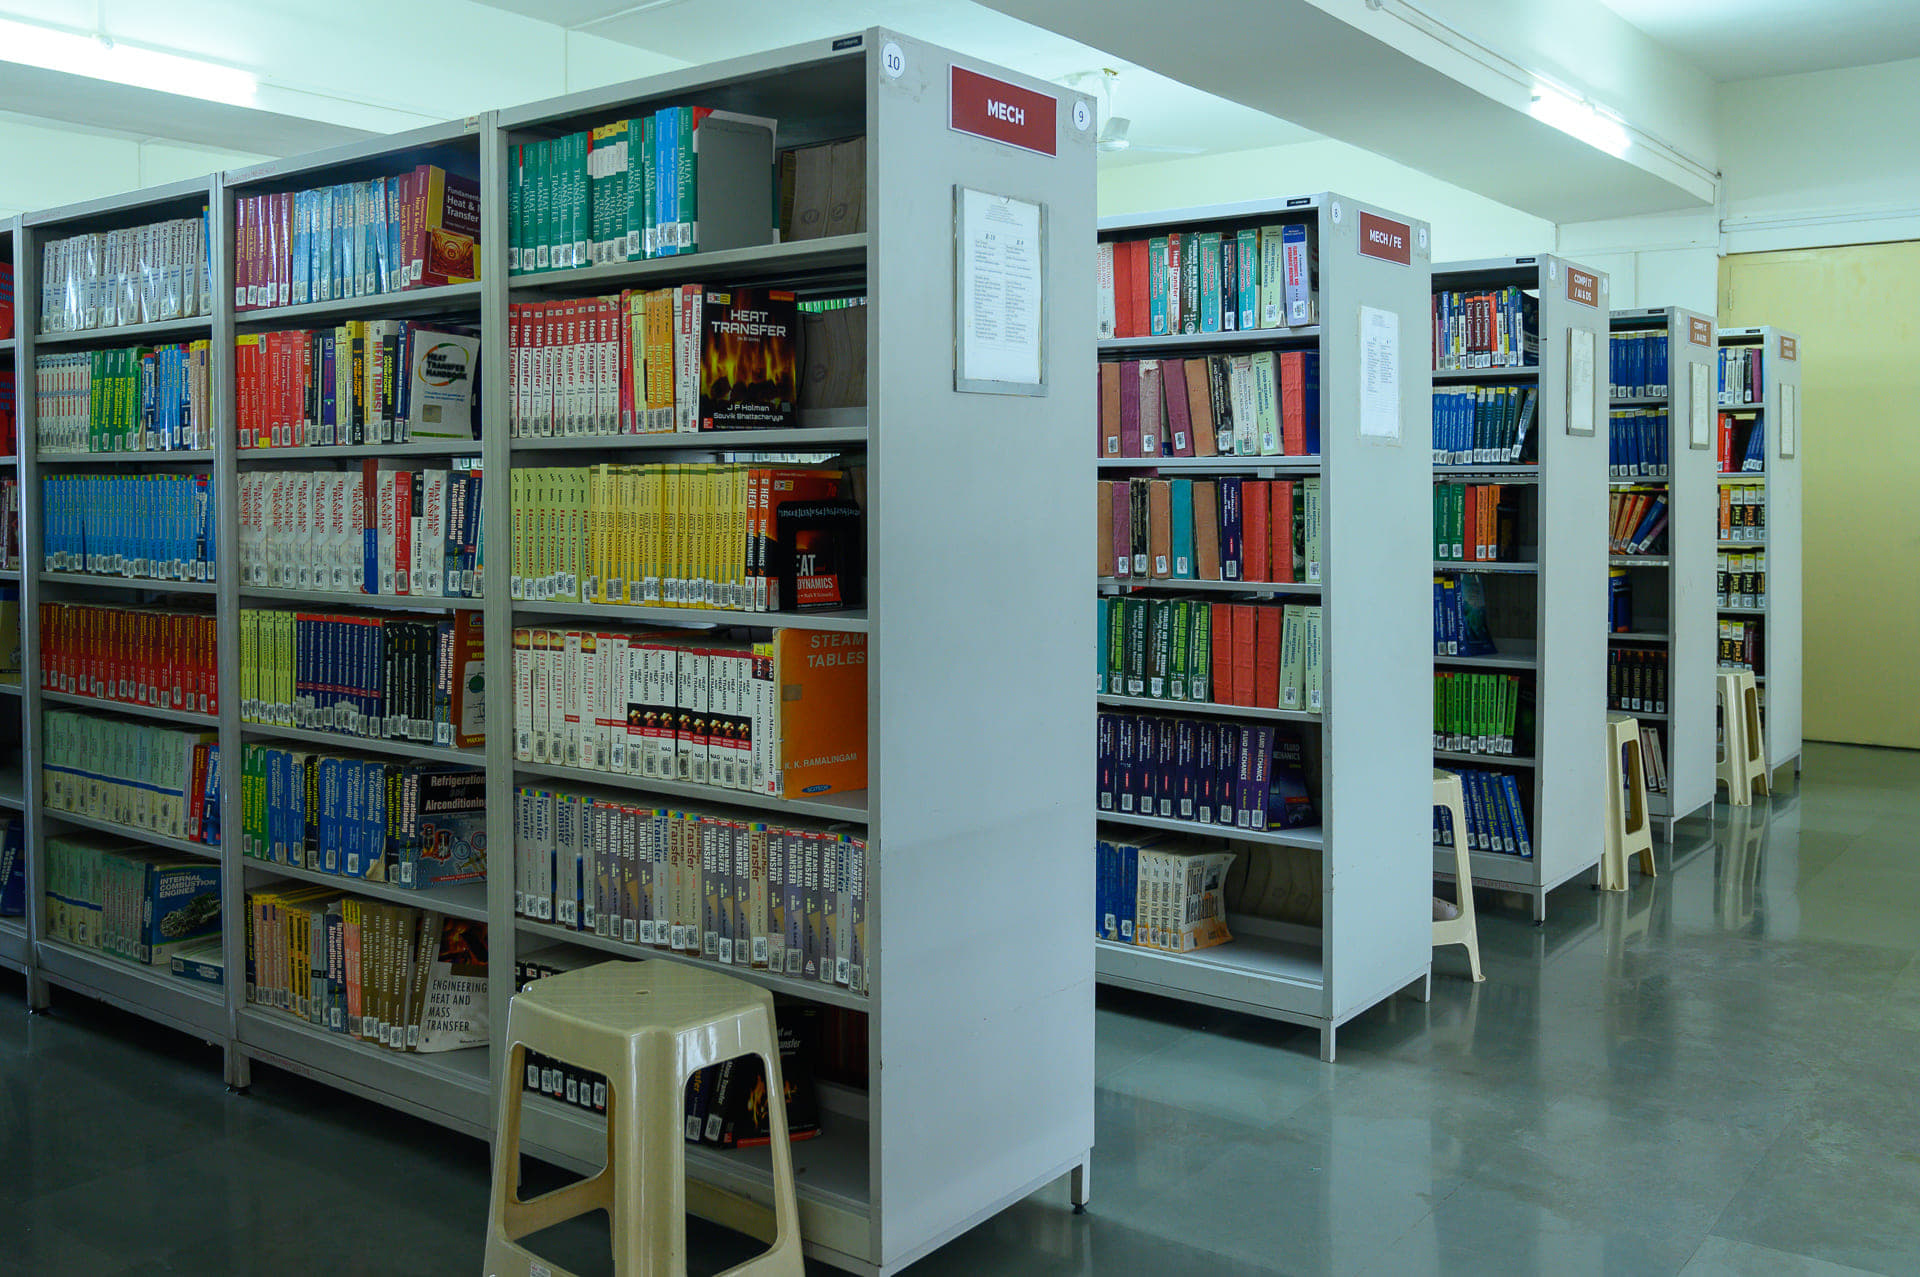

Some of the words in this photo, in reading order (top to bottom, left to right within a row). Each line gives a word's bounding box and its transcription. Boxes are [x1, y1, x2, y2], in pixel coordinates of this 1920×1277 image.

[887, 53, 900, 71] 10
[987, 98, 1024, 126] MECH
[1078, 110, 1084, 123] 9
[448, 186, 480, 200] Fundament
[447, 195, 466, 209] Heat
[468, 202, 475, 211] &
[446, 204, 479, 222] Transfer
[1369, 229, 1388, 245] MECH
[1394, 236, 1402, 249] FE
[730, 309, 769, 323] HEAT
[711, 321, 787, 337] TRANSFER
[373, 342, 382, 369] HEAT
[713, 412, 736, 420] Souvik
[741, 404, 770, 412] Holman
[457, 479, 466, 529] Refrigeration
[748, 489, 757, 509] HEAT
[760, 488, 769, 509] HEAT
[747, 519, 755, 567] THERMODYNAMICS
[758, 519, 767, 567] THERMODYNAMICS
[810, 633, 865, 649] STEAM
[807, 651, 865, 669] TABLES
[1258, 731, 1266, 747] FLUID
[794, 760, 802, 769] K.
[803, 752, 857, 767] RAMALINGAM
[431, 774, 486, 787] Refrigeration
[408, 774, 418, 822] Refrigeration
[425, 796, 486, 810] Airconditionin
[523, 798, 531, 840] Transfer
[654, 818, 663, 864] Transfer
[671, 820, 681, 868] Transfer
[751, 832, 761, 882] Transfer
[769, 841, 777, 881] TRANSFER
[788, 844, 796, 884] TRANSFER
[823, 847, 831, 888] TRANSFER
[160, 875, 202, 885] INTERNAL
[160, 880, 216, 892] COMBUSTION
[160, 887, 195, 898] ENGINES
[433, 980, 487, 993] ENGINEERING
[430, 993, 449, 1005] HEAT
[452, 995, 470, 1006] AND
[428, 1006, 451, 1018] MASS
[426, 1019, 470, 1032] TRANSFER
